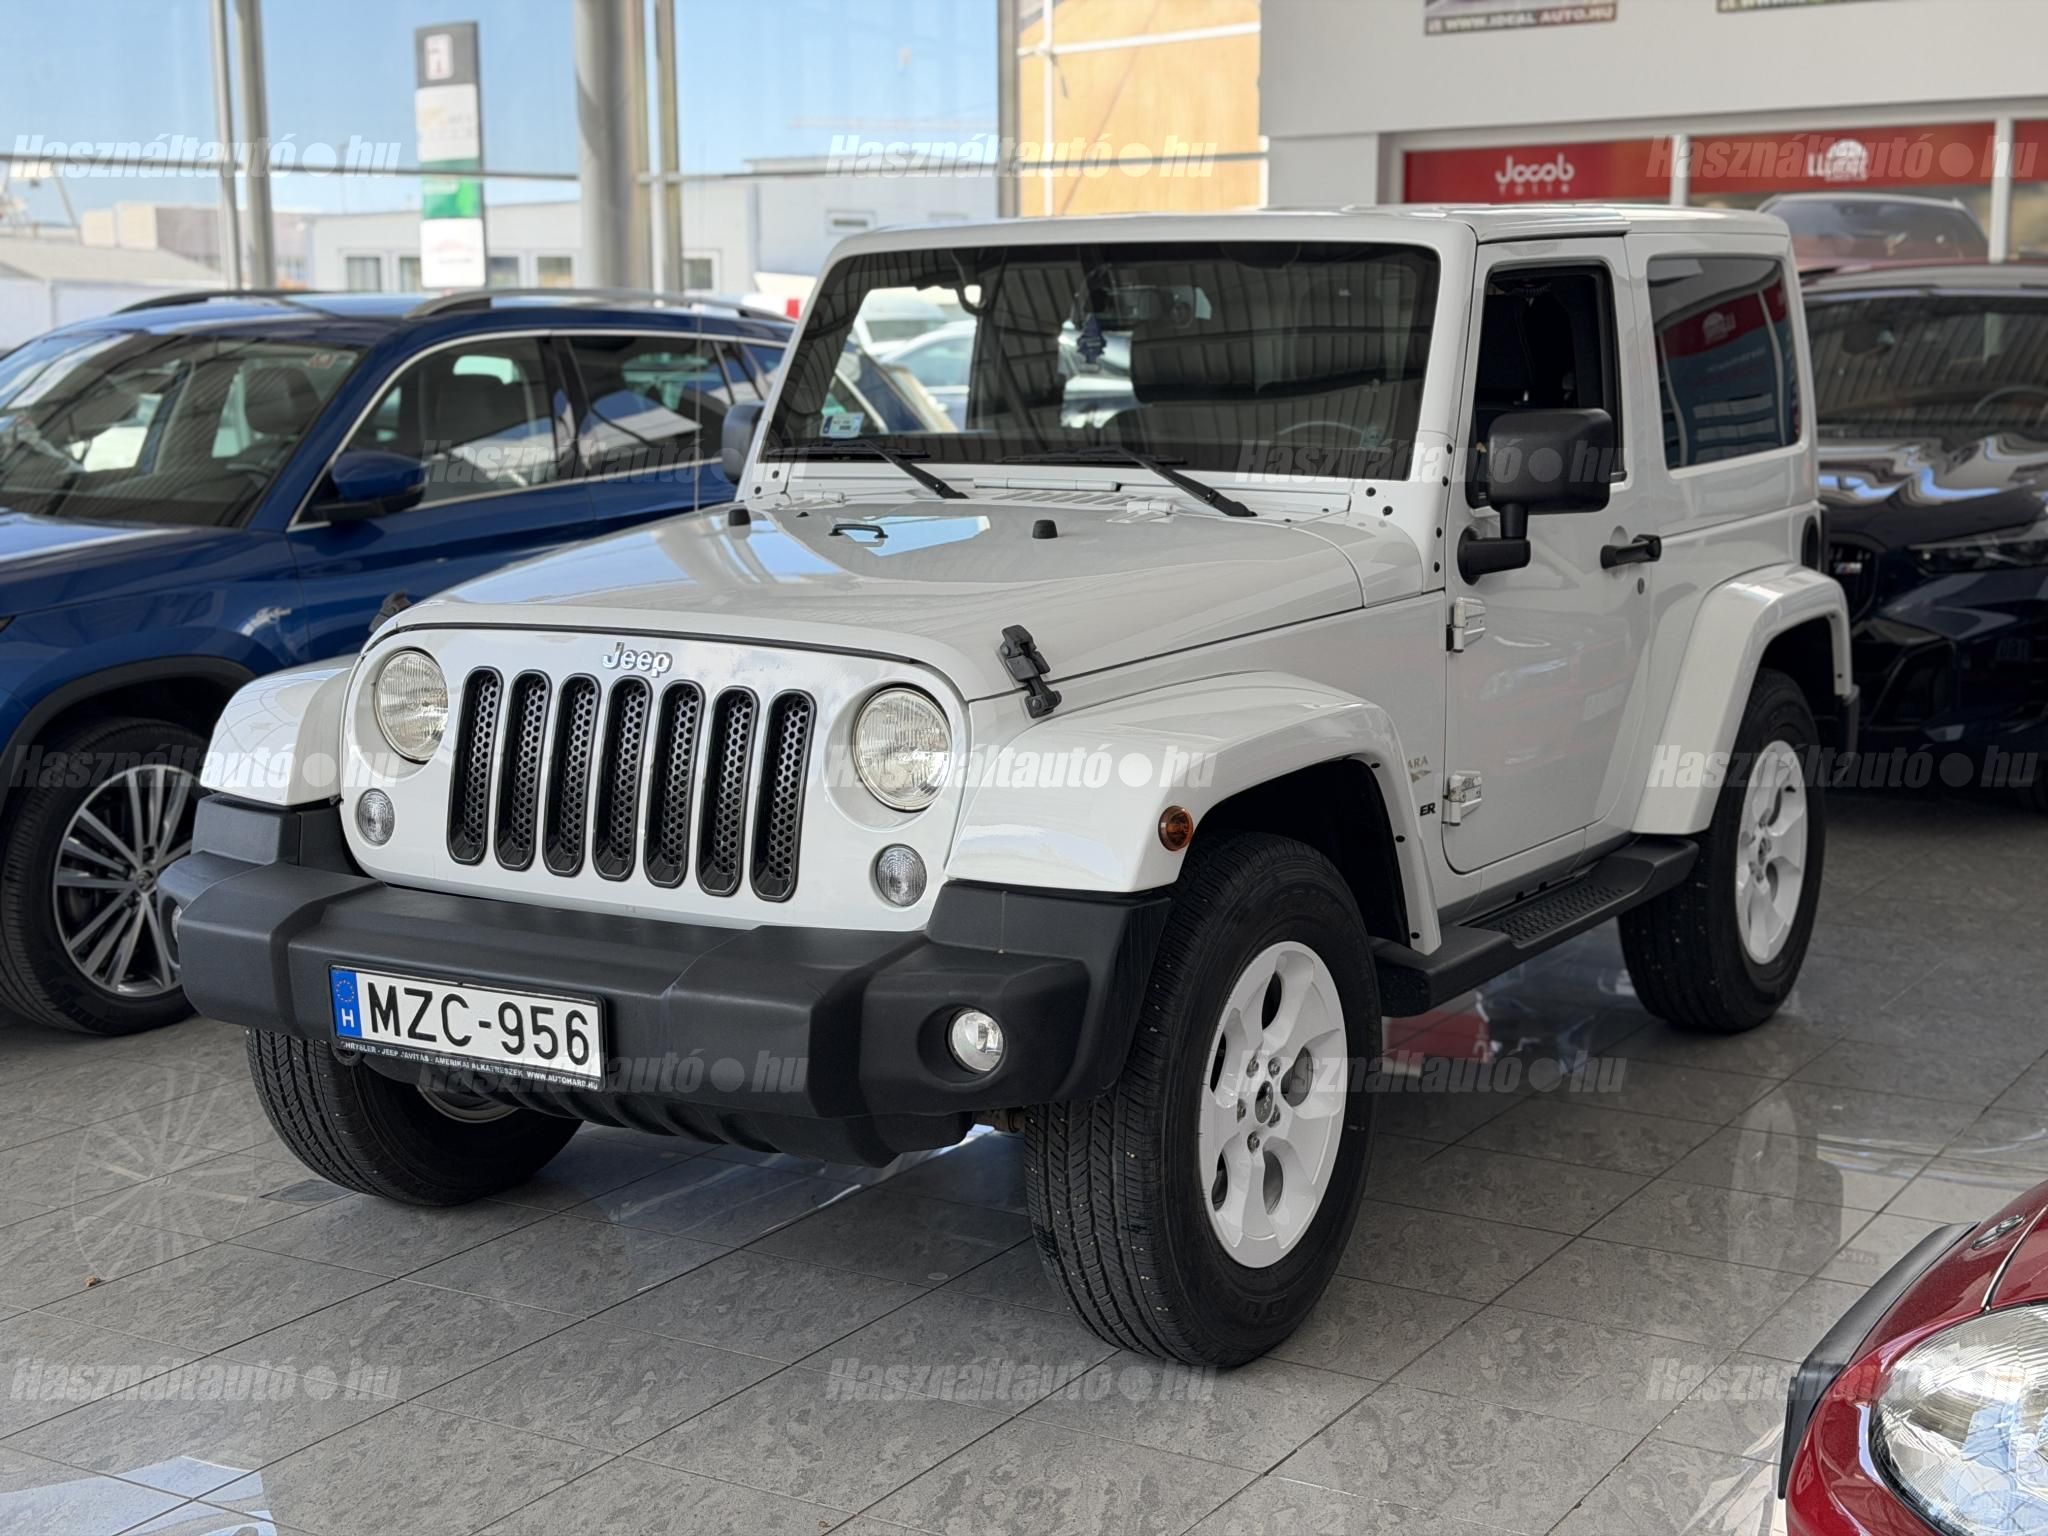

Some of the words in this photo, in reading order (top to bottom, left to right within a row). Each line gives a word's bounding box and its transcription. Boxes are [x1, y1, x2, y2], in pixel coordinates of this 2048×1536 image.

[602, 641, 673, 678] Jeep
[341, 1008, 355, 1029] H
[367, 982, 590, 1066] MZC-956
[381, 1047, 399, 1058] JEEP
